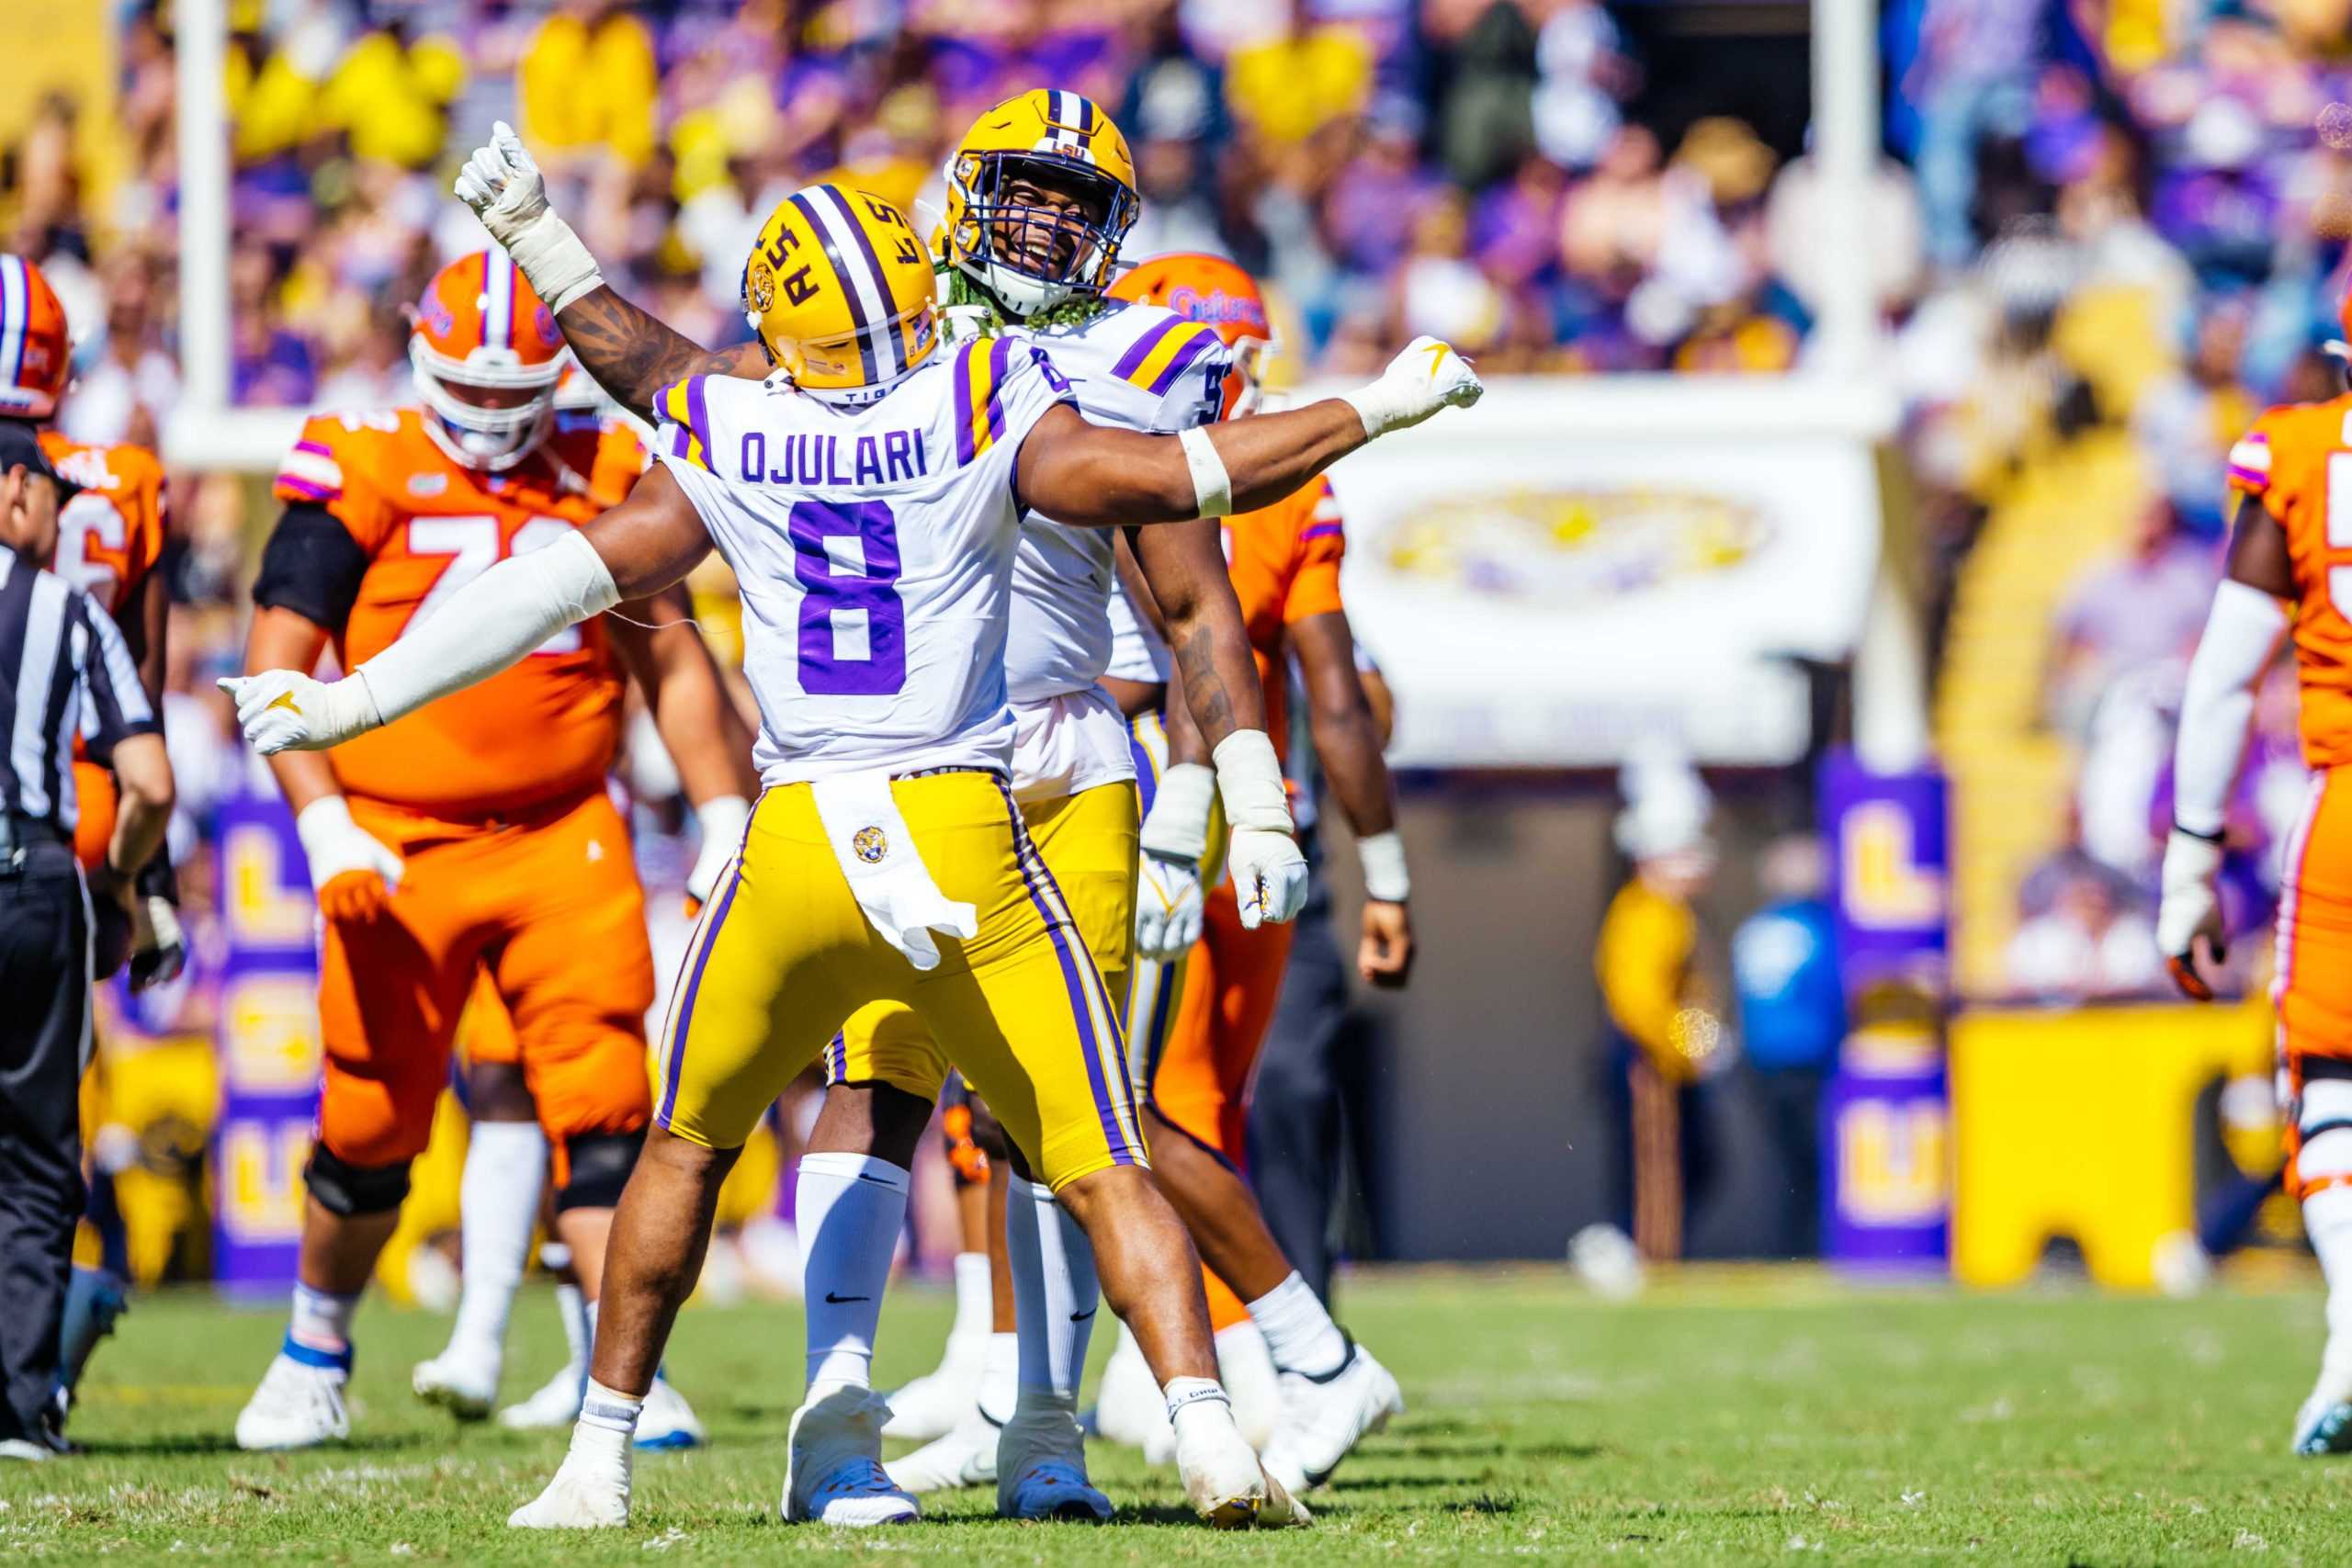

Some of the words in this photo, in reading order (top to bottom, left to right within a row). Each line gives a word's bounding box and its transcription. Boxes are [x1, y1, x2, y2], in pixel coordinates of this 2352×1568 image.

[1052, 140, 1085, 161] LSU
[863, 198, 921, 265] LS
[1197, 361, 1234, 425] 9
[741, 427, 928, 486] OJULARI
[788, 500, 907, 696] 8
